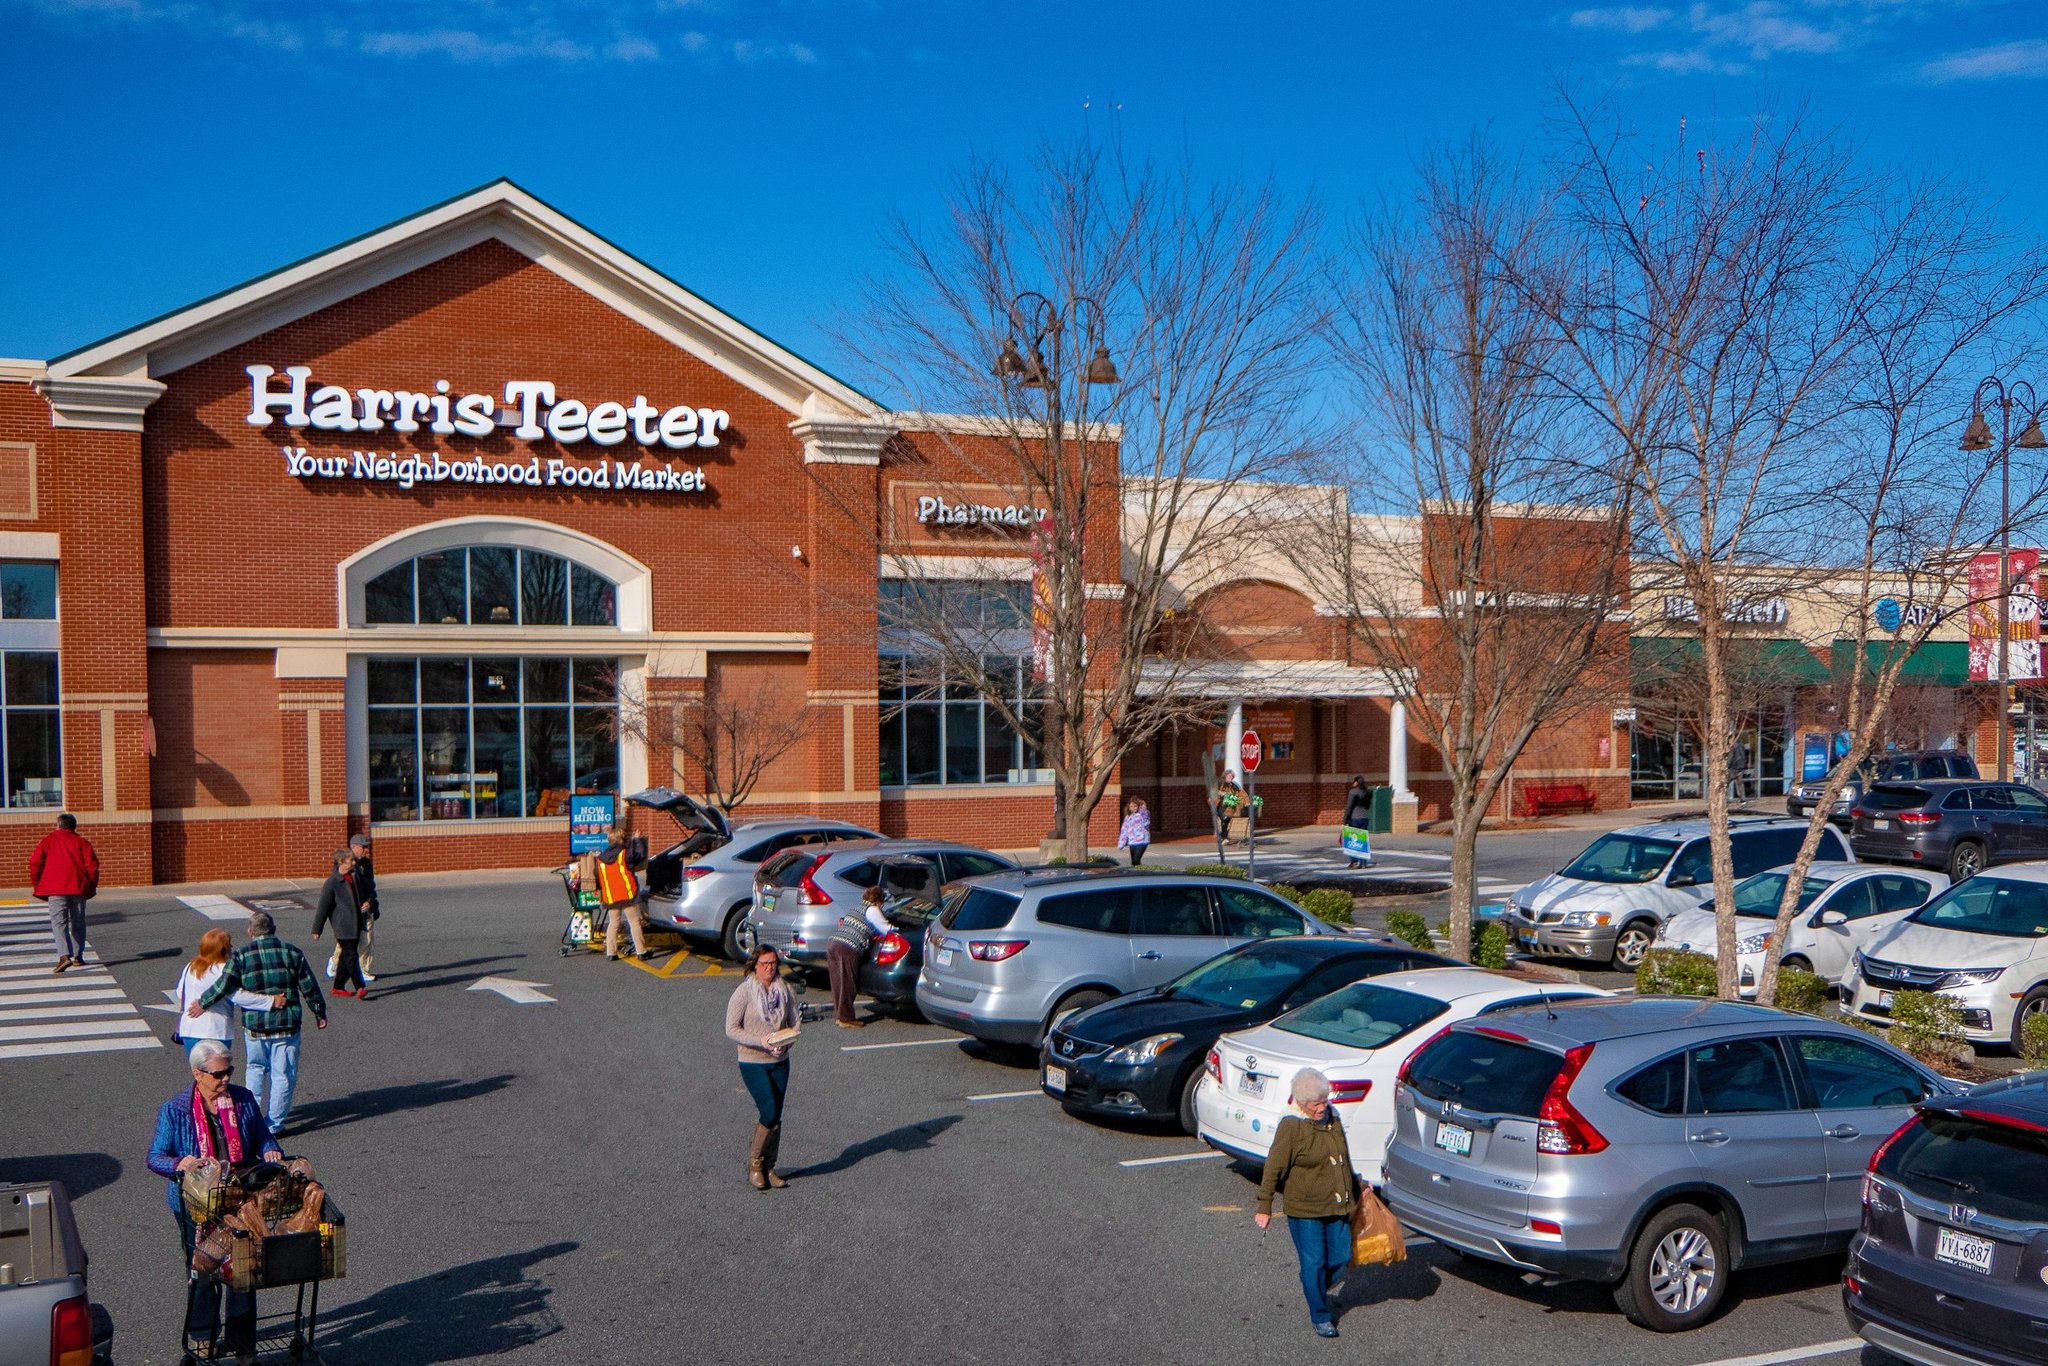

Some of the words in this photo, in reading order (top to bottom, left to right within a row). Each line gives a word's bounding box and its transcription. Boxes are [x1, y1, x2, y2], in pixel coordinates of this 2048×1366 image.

[245, 365, 495, 436] Harris
[504, 380, 730, 449] Teeter
[283, 446, 348, 476] Your
[353, 451, 542, 490] Neighborhood
[546, 459, 610, 488] Food
[614, 462, 706, 492] Market
[1241, 743, 1260, 760] STOP
[574, 814, 612, 822] HIRING
[580, 806, 606, 815] NOW
[1941, 1236, 1991, 1263] VVA-6887
